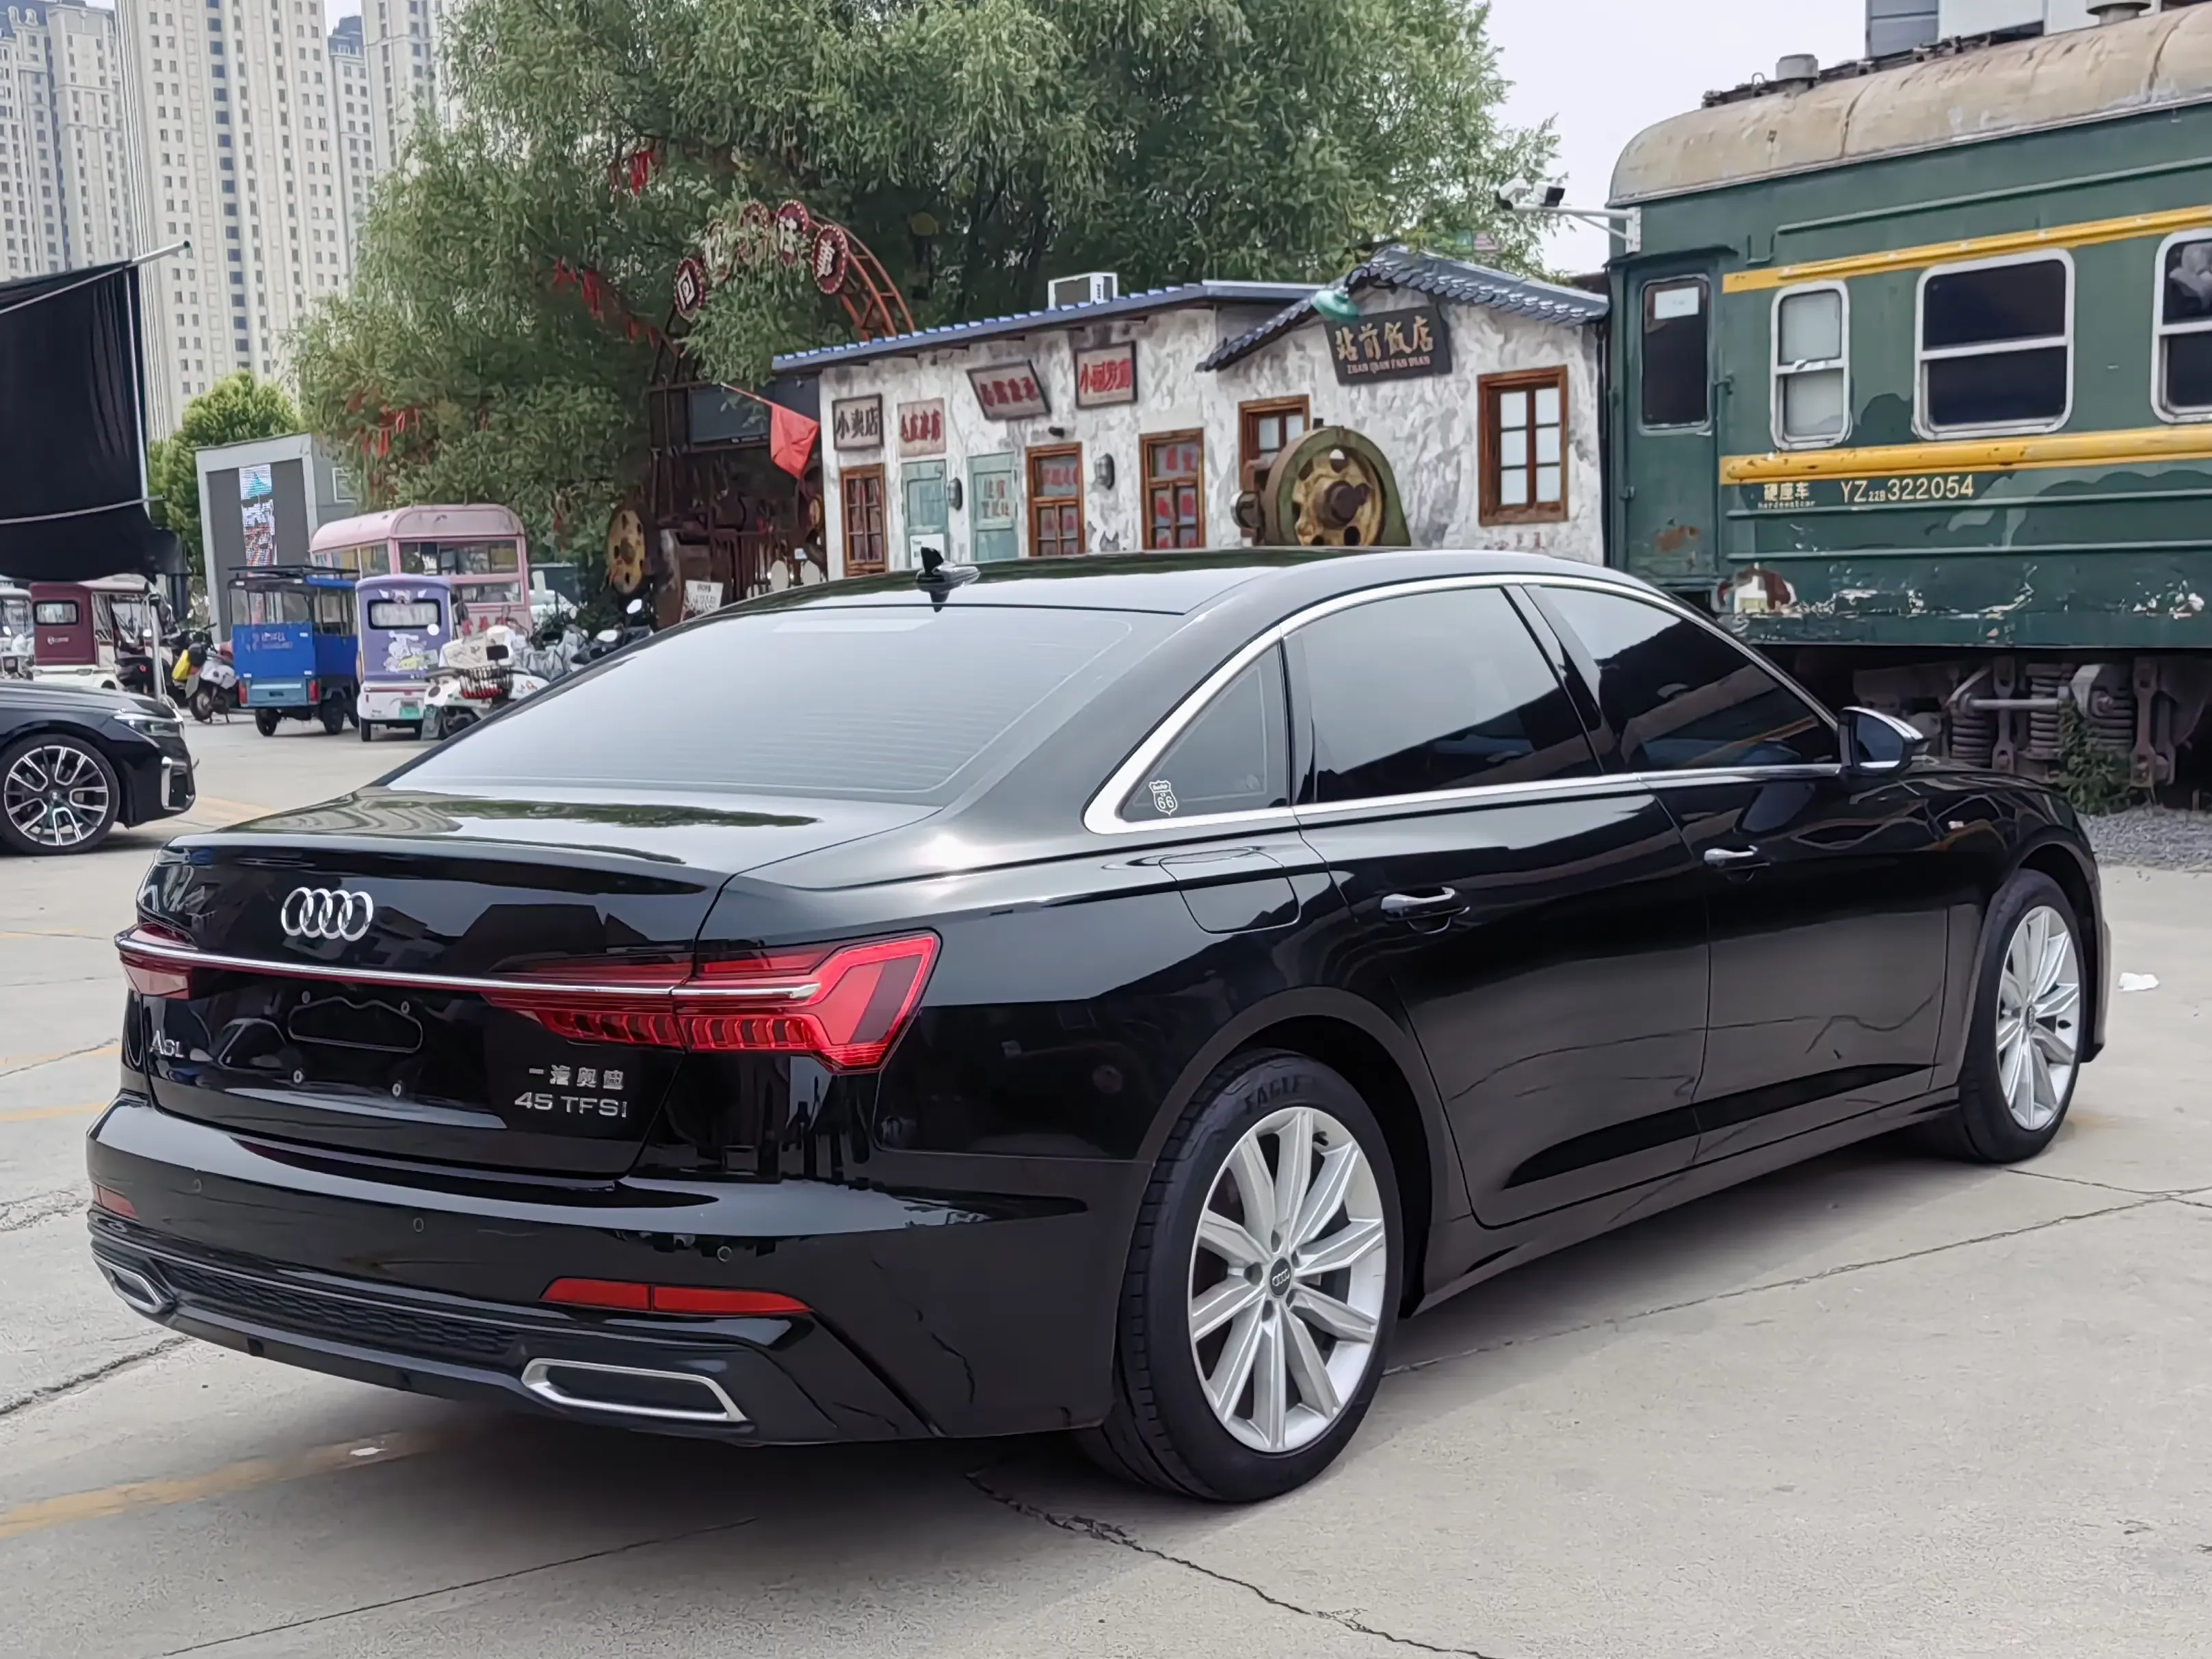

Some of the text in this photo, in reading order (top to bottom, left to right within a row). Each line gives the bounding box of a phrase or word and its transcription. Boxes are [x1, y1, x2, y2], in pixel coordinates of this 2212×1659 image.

[1157, 796, 1174, 809] 66
[149, 1030, 185, 1058] A6L
[514, 1092, 627, 1118] 45 TFSI
